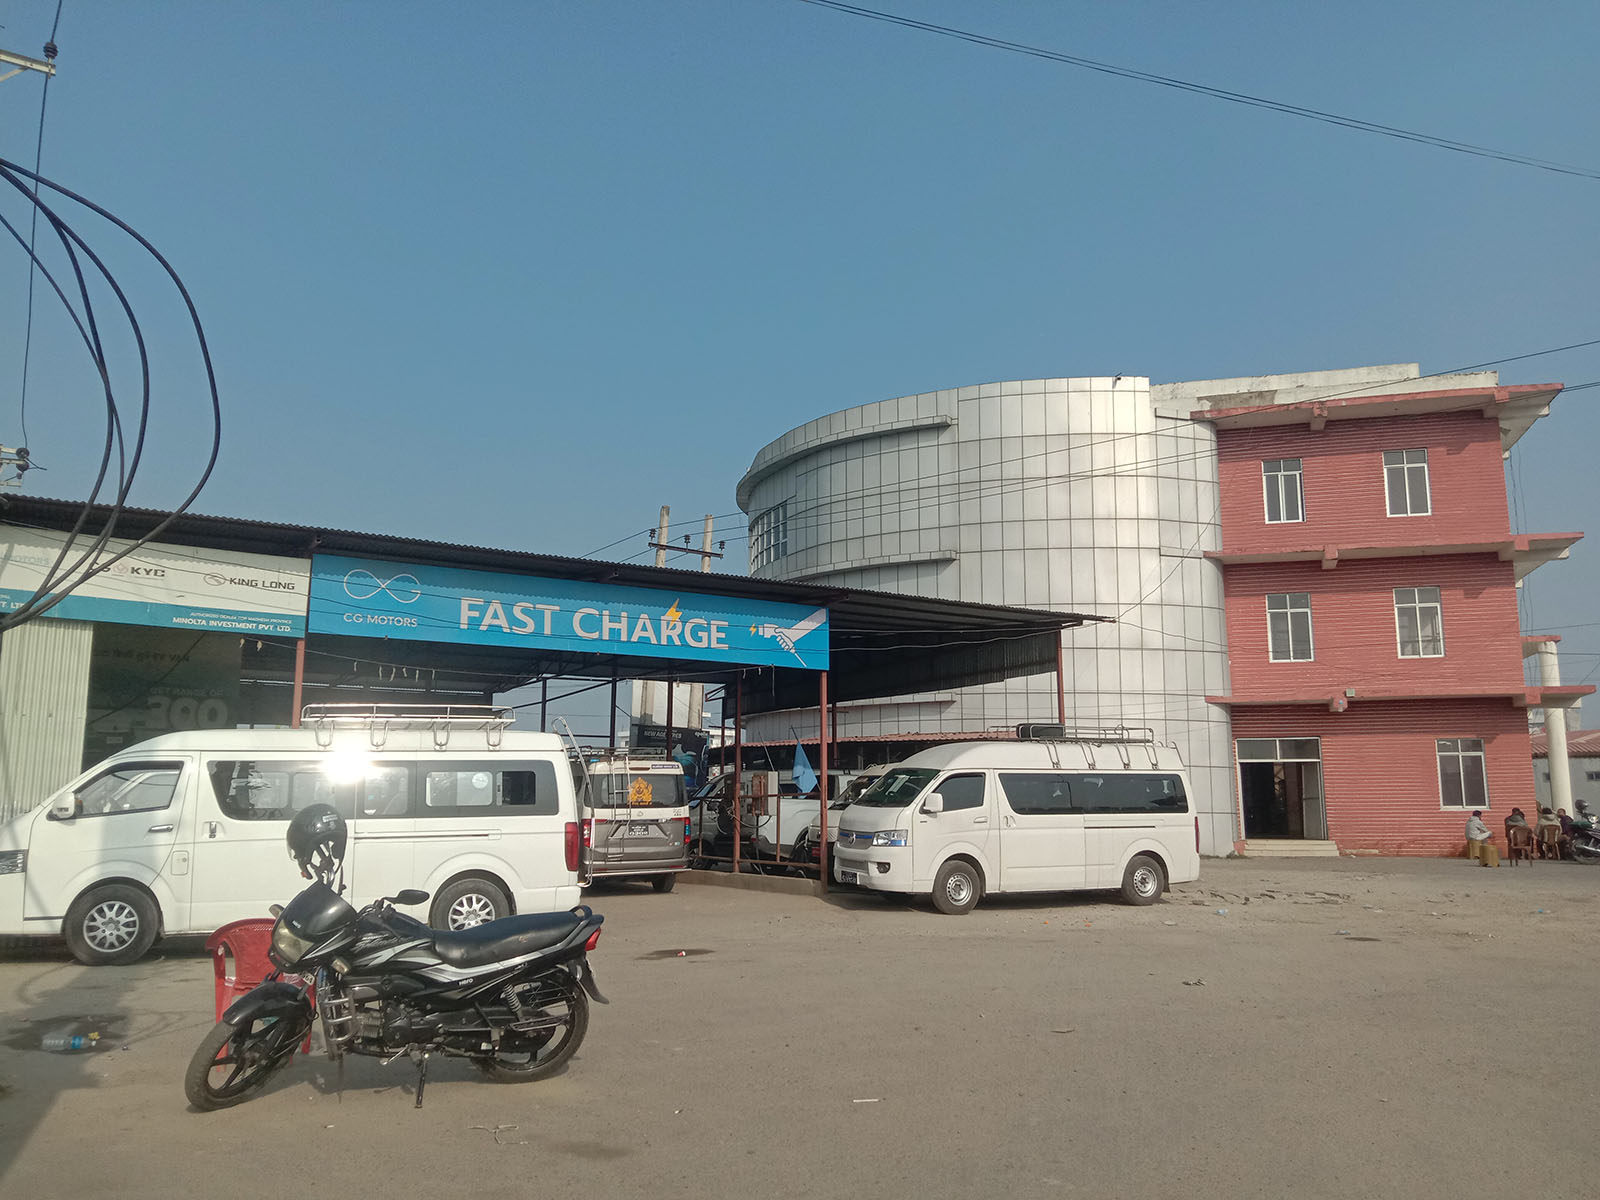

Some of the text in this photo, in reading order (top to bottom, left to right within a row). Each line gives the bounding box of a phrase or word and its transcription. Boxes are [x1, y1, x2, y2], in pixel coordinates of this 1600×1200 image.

[130, 566, 165, 578] KYC
[229, 577, 295, 591] KING LONG
[172, 616, 206, 626] MINOLTA
[209, 620, 256, 630] INVESTMENT
[343, 613, 418, 628] CG MOTORS
[460, 597, 729, 650] FAST CHARGE
